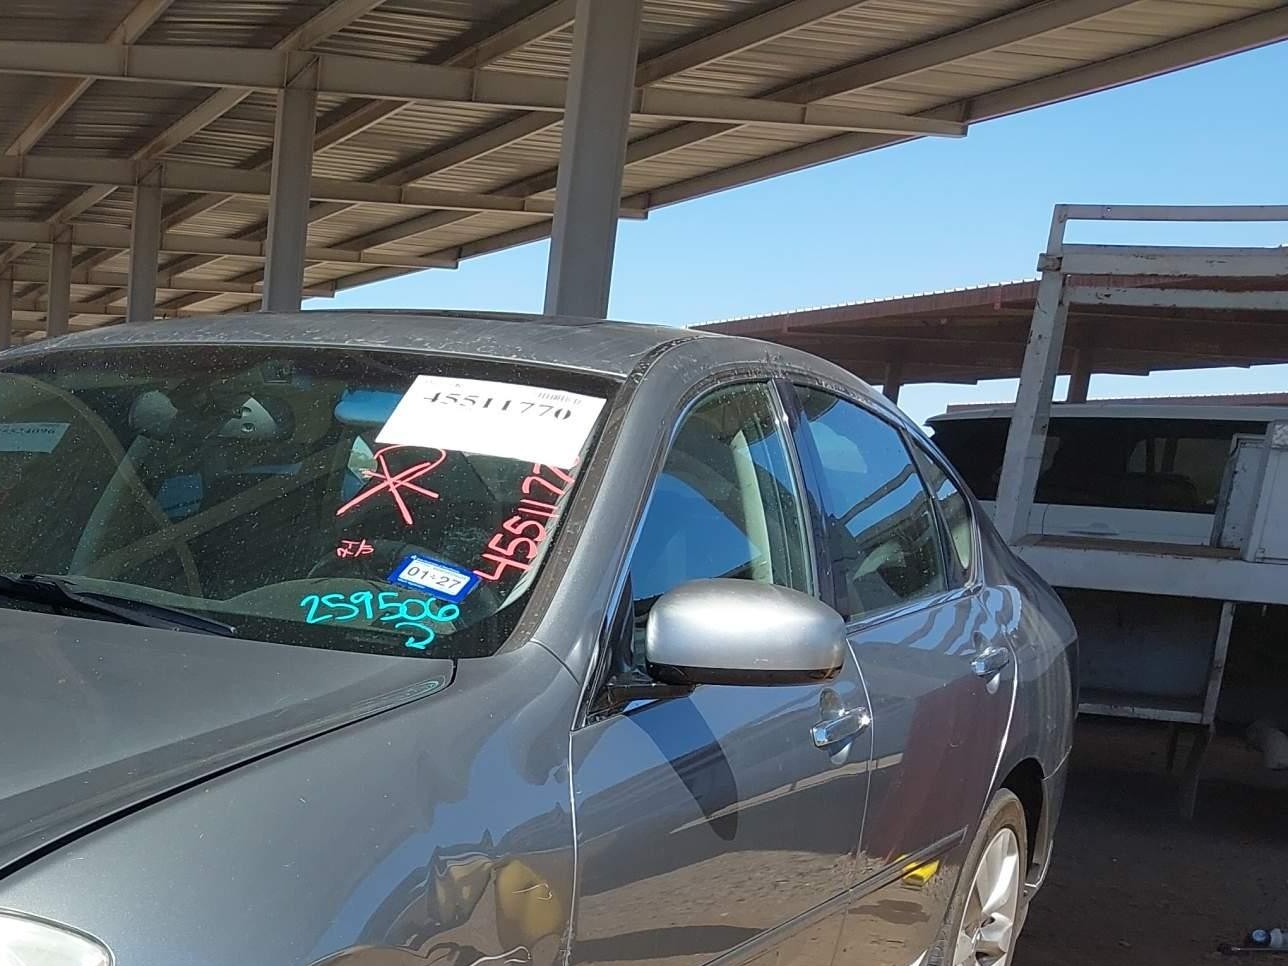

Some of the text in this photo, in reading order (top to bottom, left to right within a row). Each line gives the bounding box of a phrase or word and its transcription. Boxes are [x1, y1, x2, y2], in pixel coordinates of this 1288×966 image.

[423, 391, 572, 420] 45511770
[472, 456, 578, 581] 4551177
[407, 566, 462, 589] 01-27
[300, 590, 460, 624] 259506
